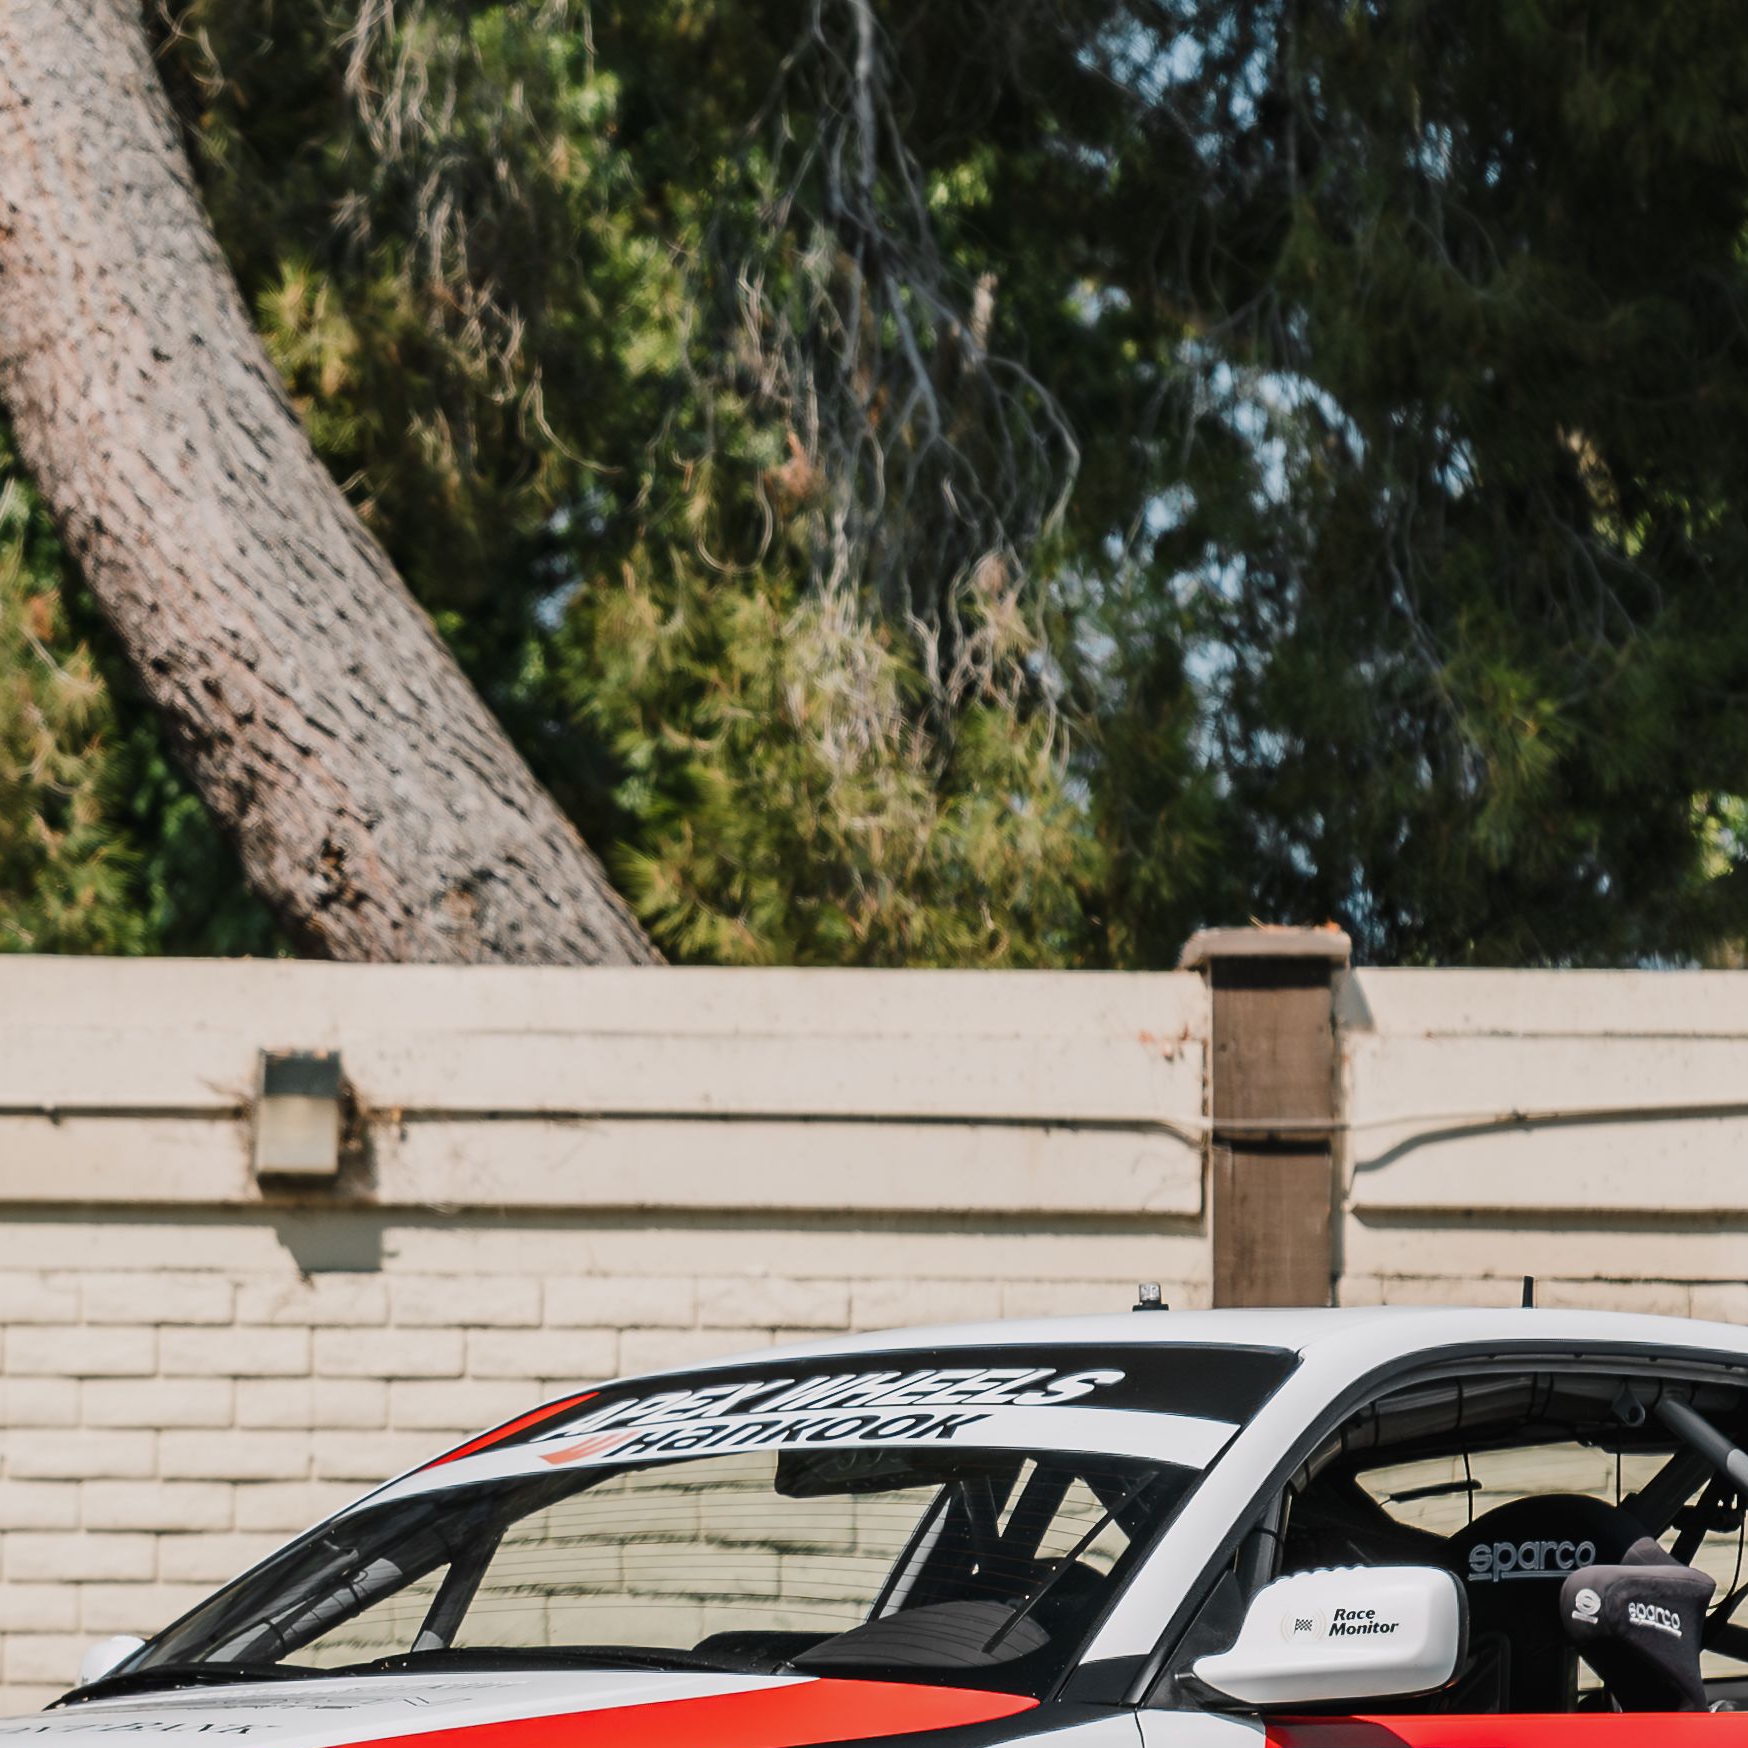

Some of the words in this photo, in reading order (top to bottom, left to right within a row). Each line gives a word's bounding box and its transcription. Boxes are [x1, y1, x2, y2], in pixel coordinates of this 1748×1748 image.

[749, 1368, 1125, 1413] WHEELS
[1469, 1540, 1596, 1582] sparco
[1333, 1608, 1376, 1621] Race
[1628, 1602, 1681, 1630] sparco
[1328, 1621, 1400, 1637] Monitor
